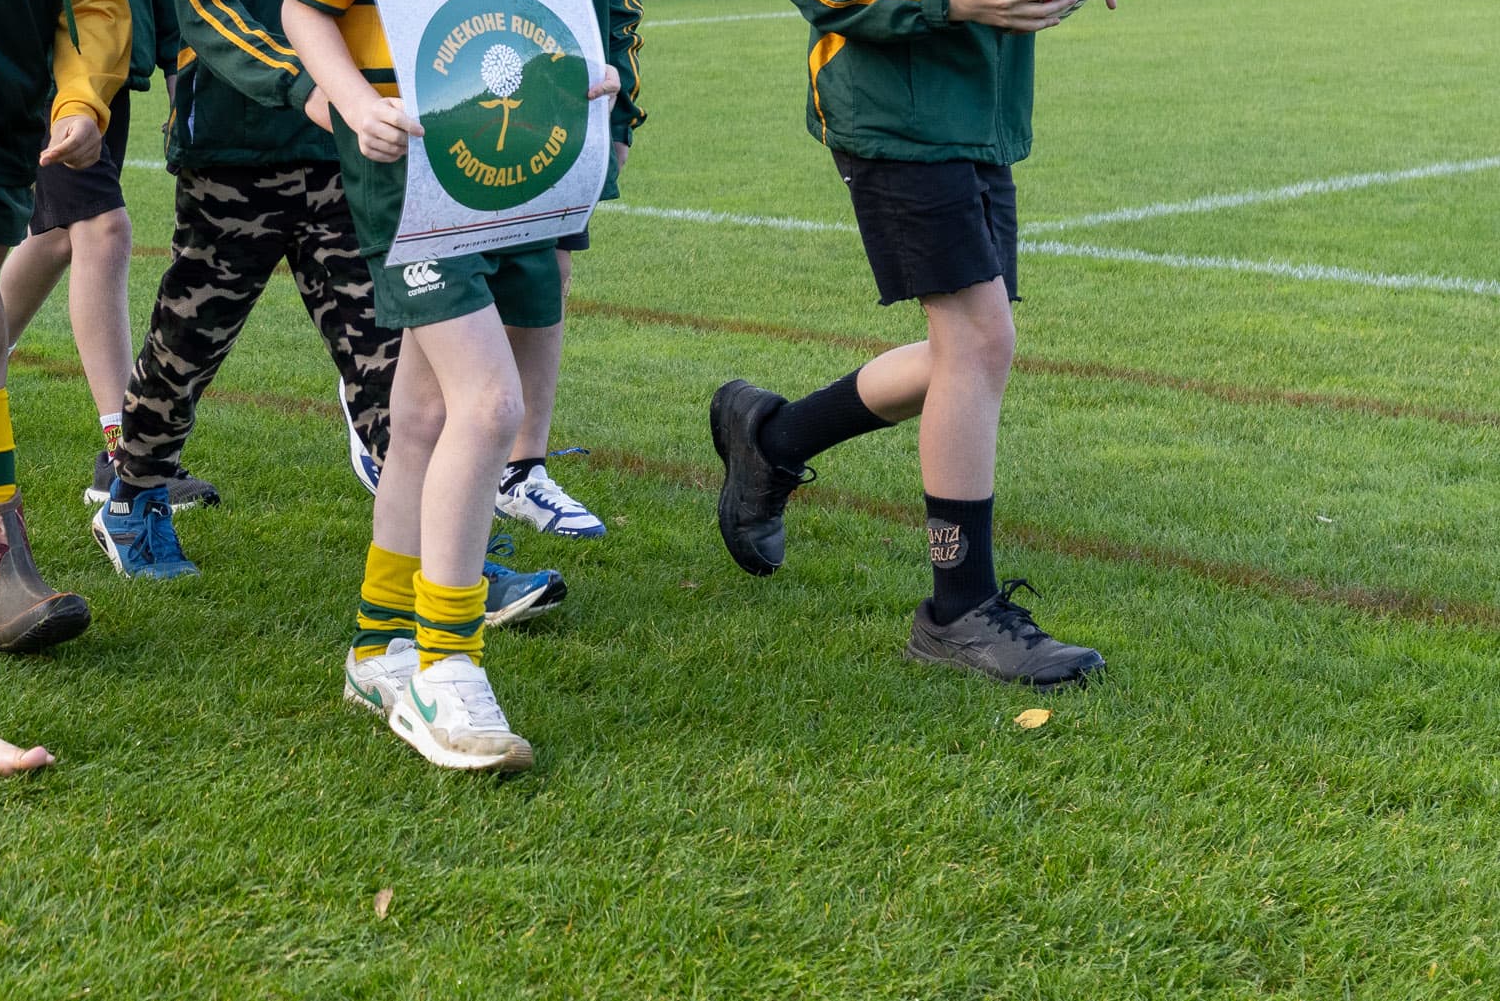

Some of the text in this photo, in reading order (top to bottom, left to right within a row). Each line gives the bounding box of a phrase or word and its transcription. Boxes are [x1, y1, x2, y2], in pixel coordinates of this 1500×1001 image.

[432, 12, 567, 77] PUKEKOHE RUGBY
[448, 125, 568, 188] FOOTBALL CLUB
[407, 281, 446, 297] canterbury
